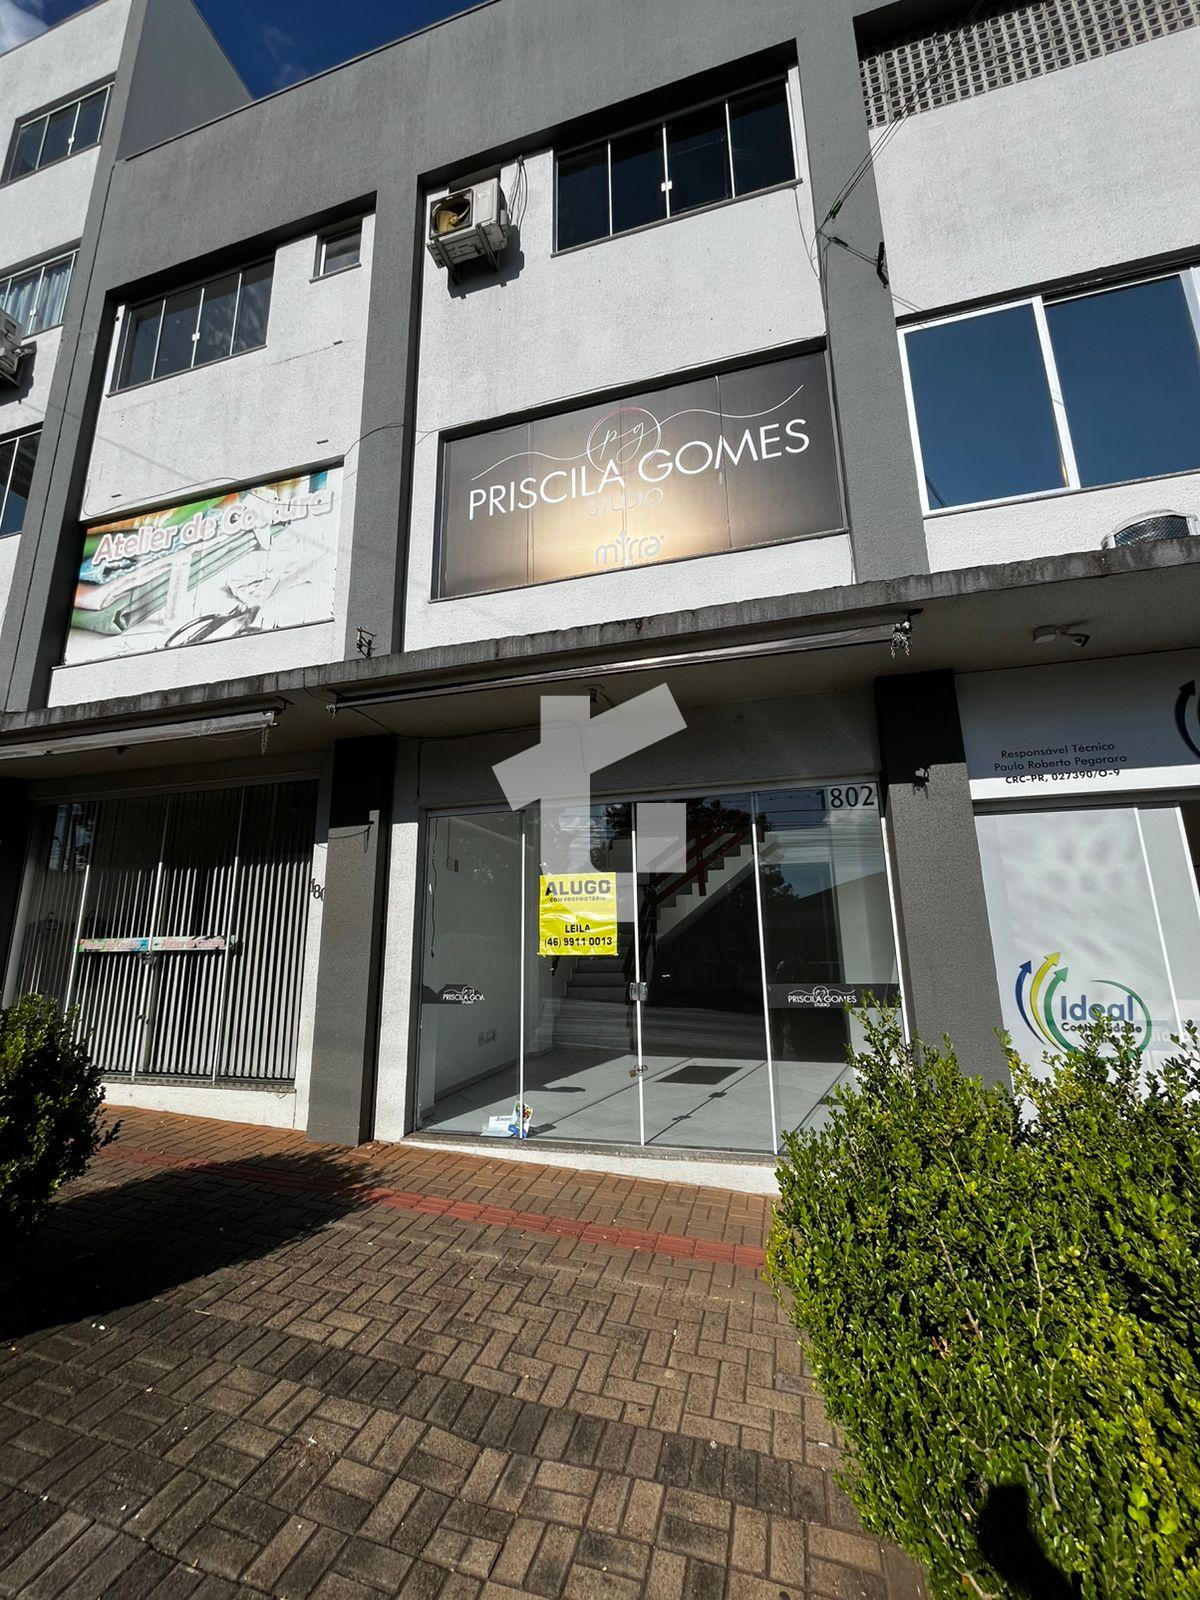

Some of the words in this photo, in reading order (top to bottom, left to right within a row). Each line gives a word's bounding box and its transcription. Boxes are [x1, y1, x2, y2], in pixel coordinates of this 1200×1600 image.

[468, 458, 625, 520] PRISCILA
[638, 418, 811, 484] GOMES
[585, 487, 665, 518] STUDIO
[93, 525, 178, 565] Atelier
[181, 512, 218, 545] de
[1072, 741, 1115, 753] Técnico
[994, 761, 1024, 772] Paulo
[1028, 758, 1071, 769] Roberto
[1074, 754, 1127, 768] Pegoraro
[1005, 773, 1048, 784] CRC-PR,
[1052, 769, 1120, 781] 027390/O-9
[815, 785, 875, 809] 1802
[545, 879, 611, 896] ALUGO
[565, 924, 590, 933] LEILA
[544, 937, 561, 948] (46)
[563, 937, 586, 947] 9911
[589, 936, 612, 946] 0013
[788, 995, 821, 1003] PRISCILA
[823, 995, 857, 1003] GOMES
[1060, 994, 1134, 1021] Ideal
